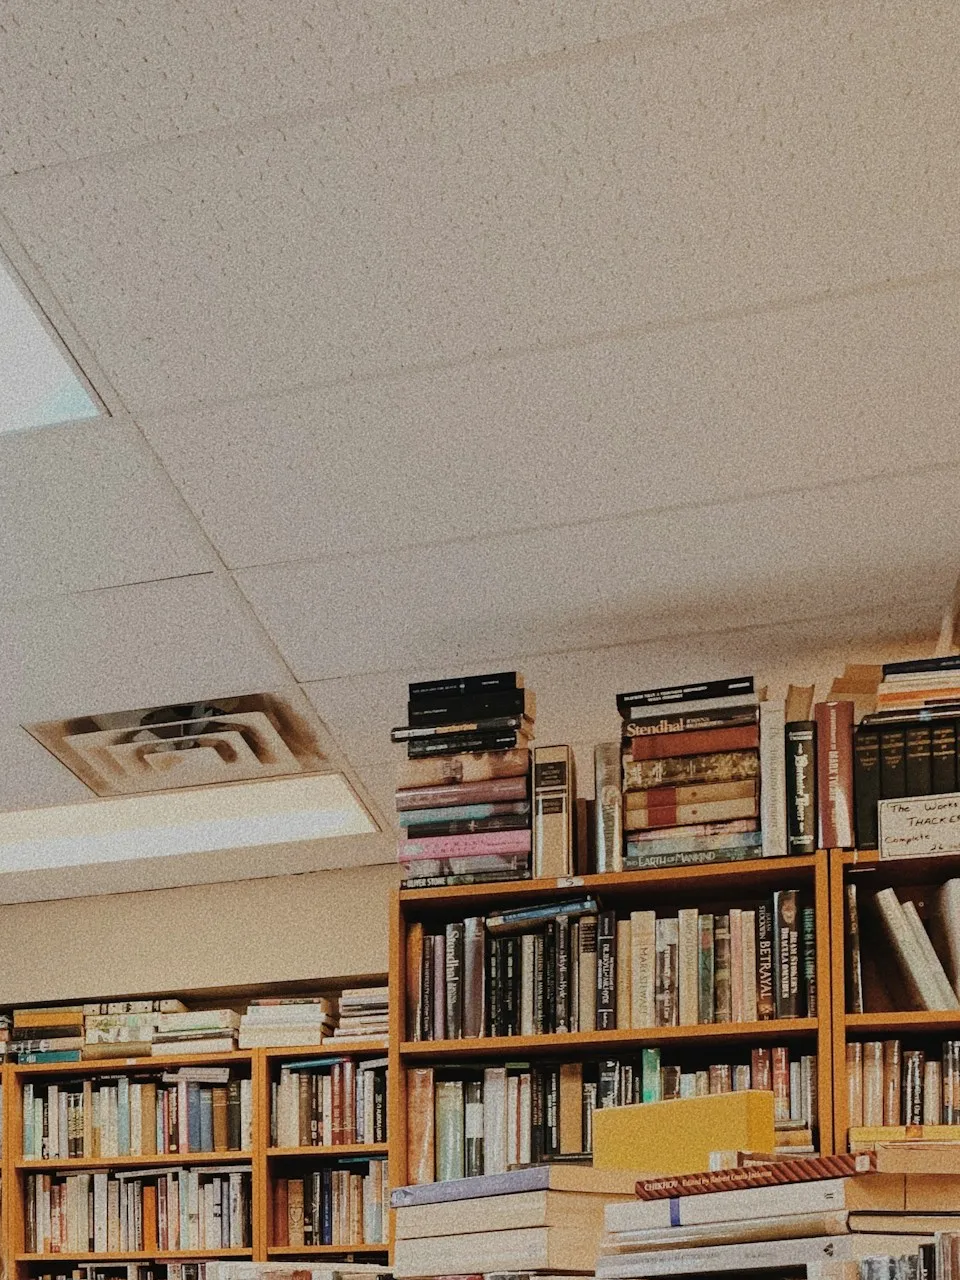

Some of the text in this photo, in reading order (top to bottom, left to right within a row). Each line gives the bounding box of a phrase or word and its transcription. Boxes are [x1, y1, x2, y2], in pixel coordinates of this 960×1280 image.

[626, 718, 685, 737] Stendhal
[828, 751, 839, 775] MARK
[446, 930, 460, 982] Stendhal
[781, 927, 789, 961] DRACULA
[639, 947, 648, 974] MARY
[759, 940, 771, 1006] BETRAYAL
